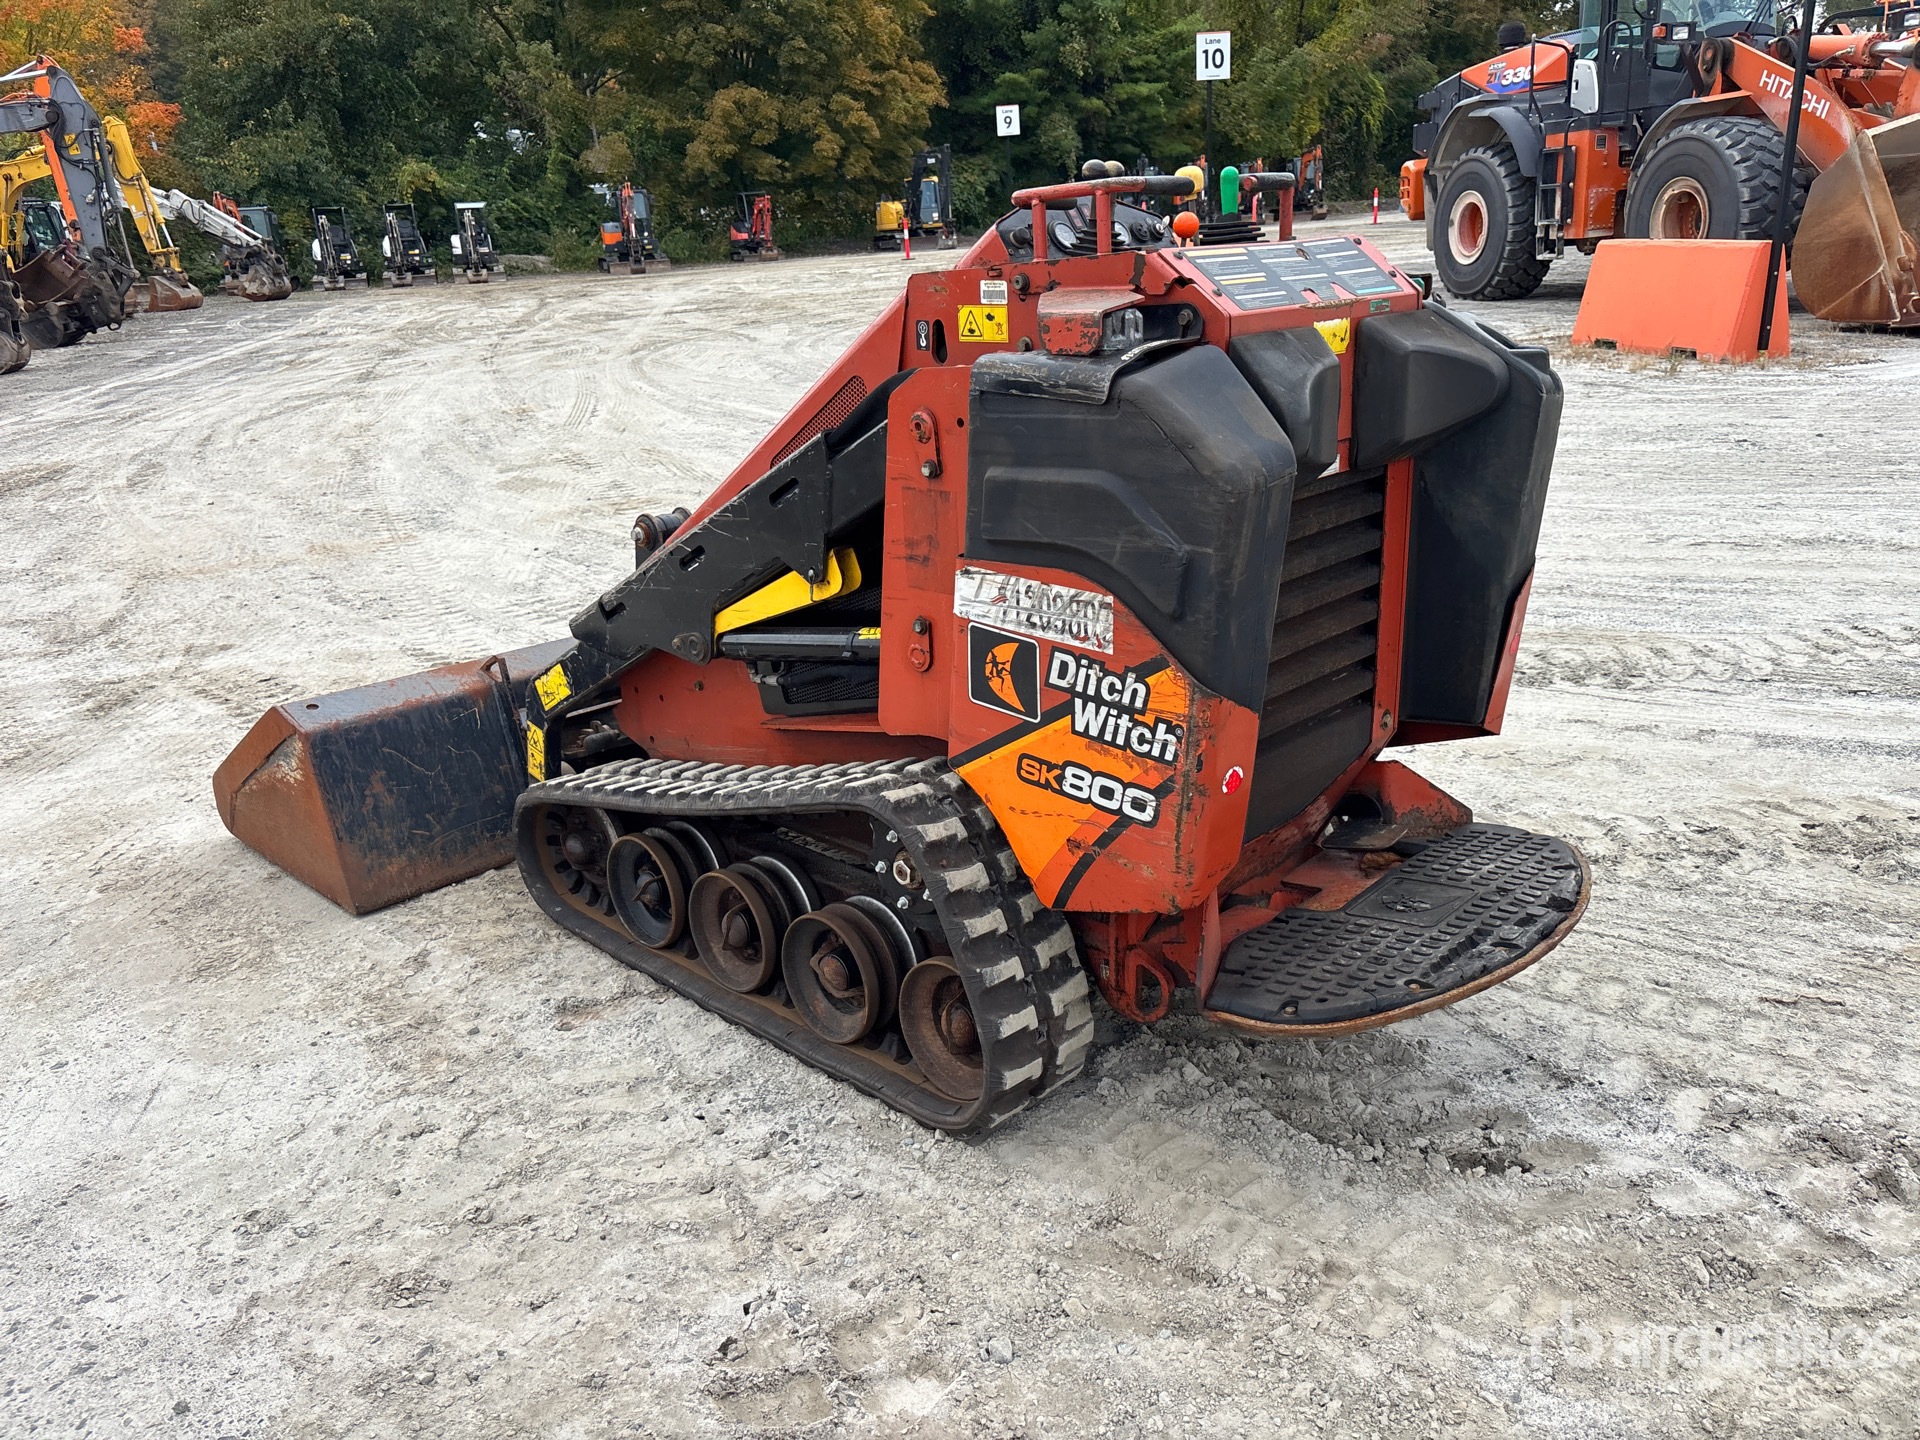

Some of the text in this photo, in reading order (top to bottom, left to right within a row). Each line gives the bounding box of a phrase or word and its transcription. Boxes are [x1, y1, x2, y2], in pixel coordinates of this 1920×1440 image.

[1202, 48, 1224, 70] 10
[1004, 115, 1012, 129] 9
[1048, 651, 1147, 710] Ditch
[1074, 697, 1178, 762] Witch
[1020, 757, 1157, 823] SK800
